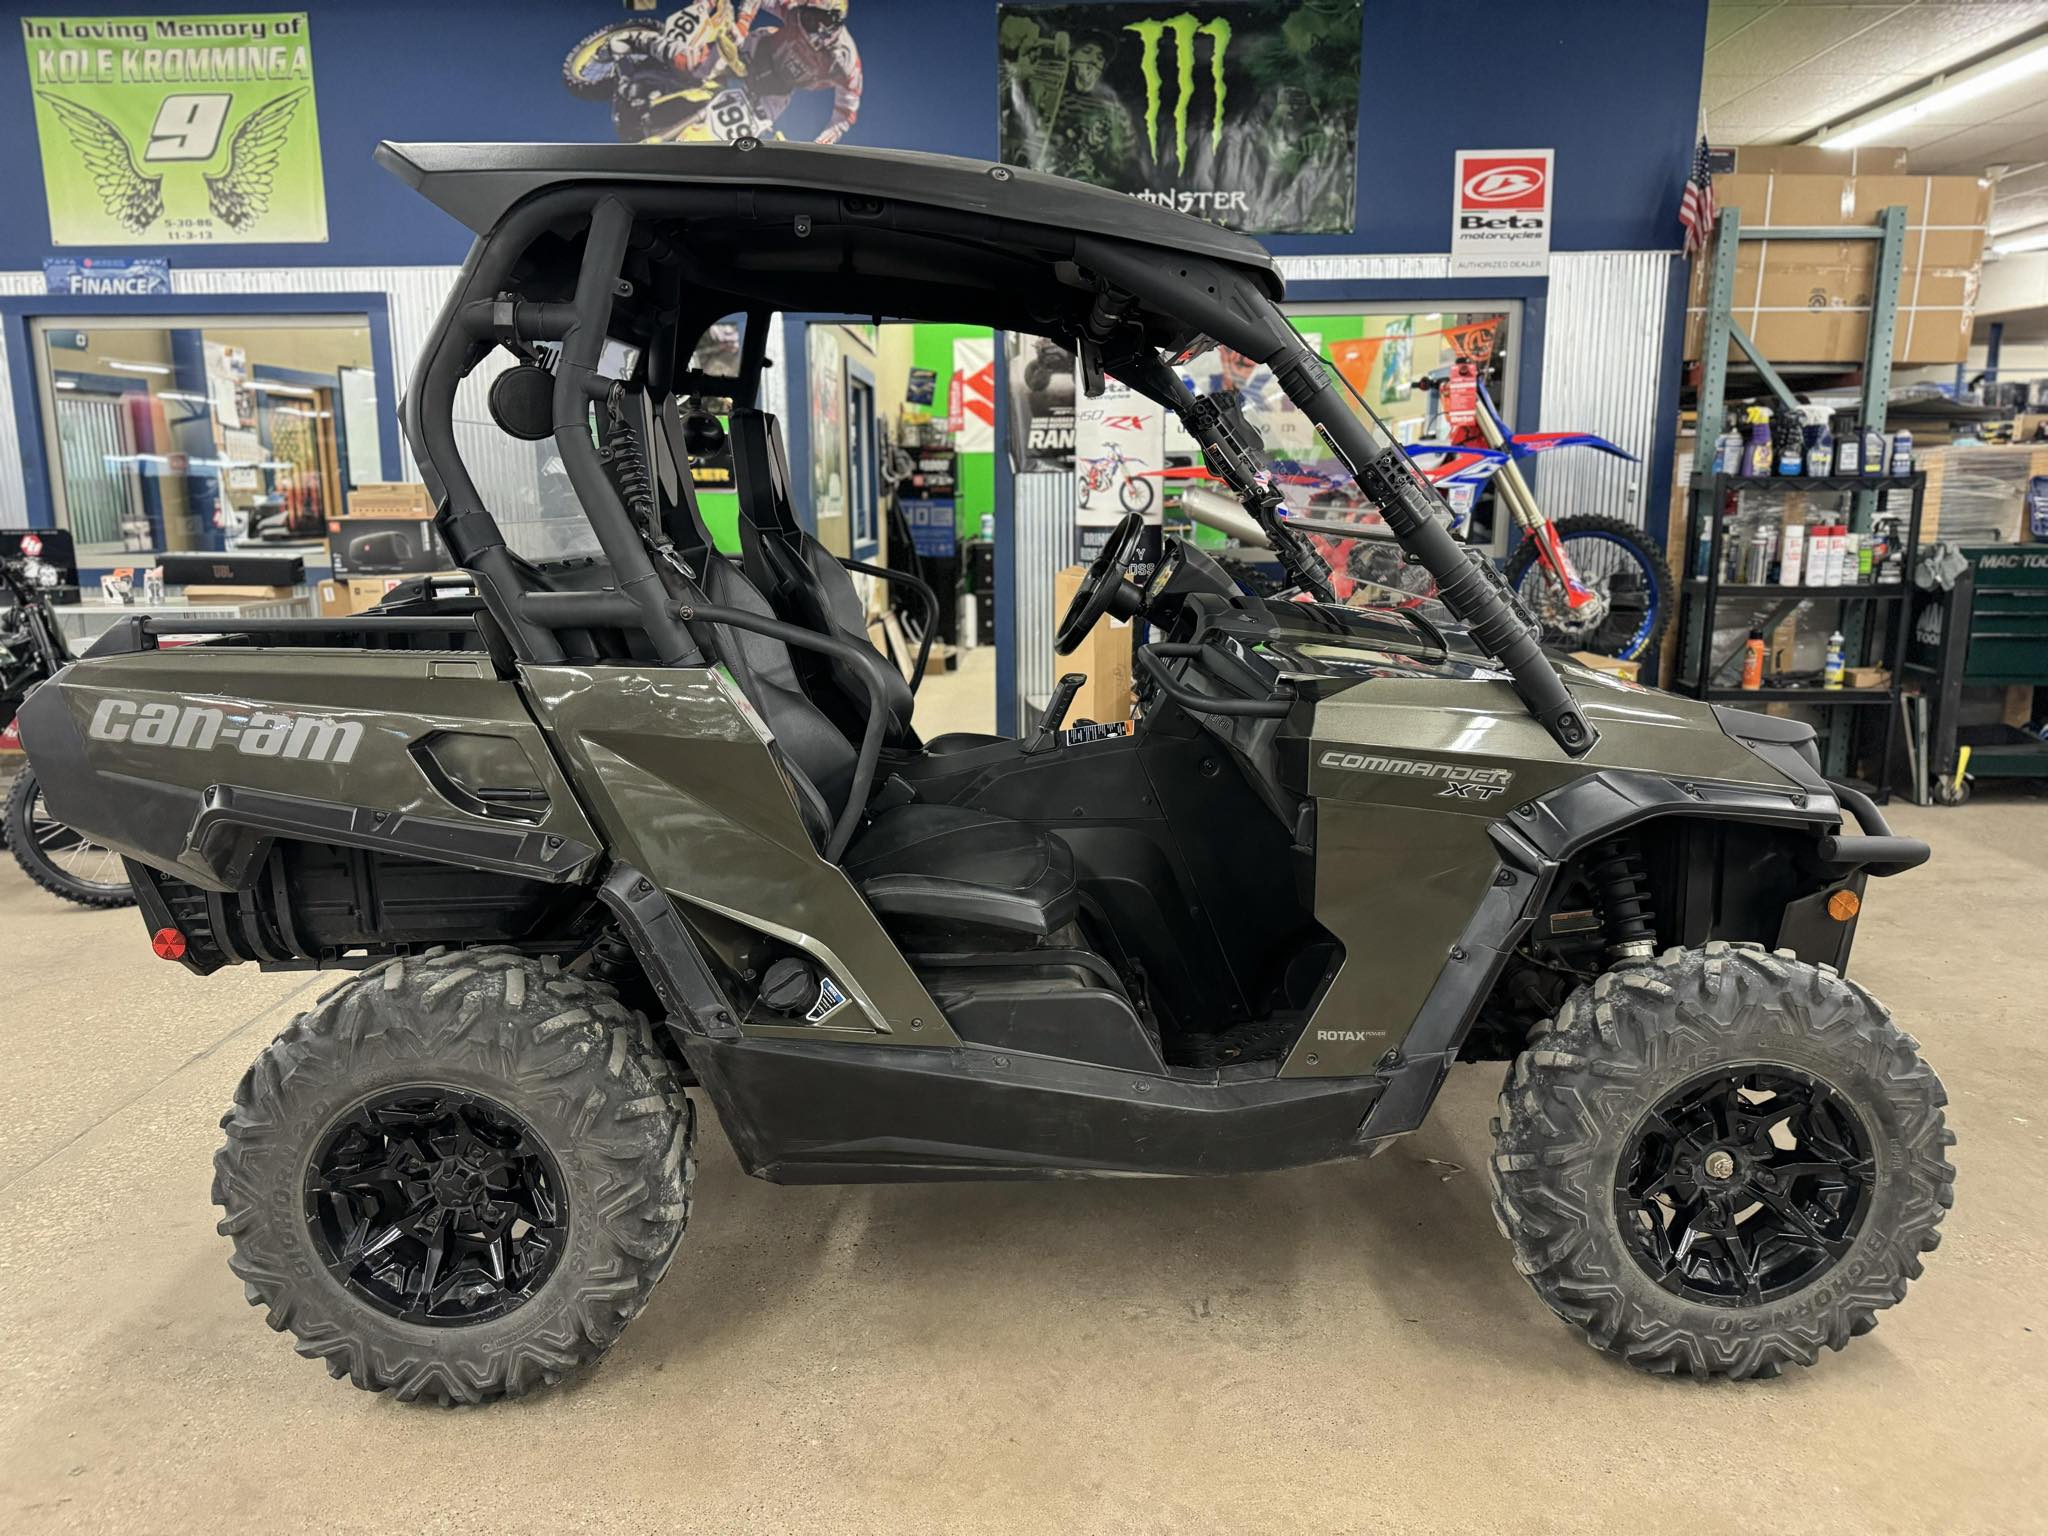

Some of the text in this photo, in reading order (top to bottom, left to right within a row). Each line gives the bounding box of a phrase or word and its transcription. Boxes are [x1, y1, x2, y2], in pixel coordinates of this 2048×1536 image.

[25, 18, 302, 41] In Loving Memory of
[37, 46, 310, 84] KOLE KROMMINGA
[144, 93, 234, 162] 9
[1460, 215, 1544, 230] Beta
[1460, 231, 1542, 241] motorcycles
[1510, 260, 1542, 268] DEALER
[1978, 554, 2019, 569] MAC
[88, 699, 364, 764] can-am
[1319, 752, 1514, 785] COMMANDER
[1437, 781, 1505, 800] XT
[1317, 1030, 1366, 1041] ROTAX
